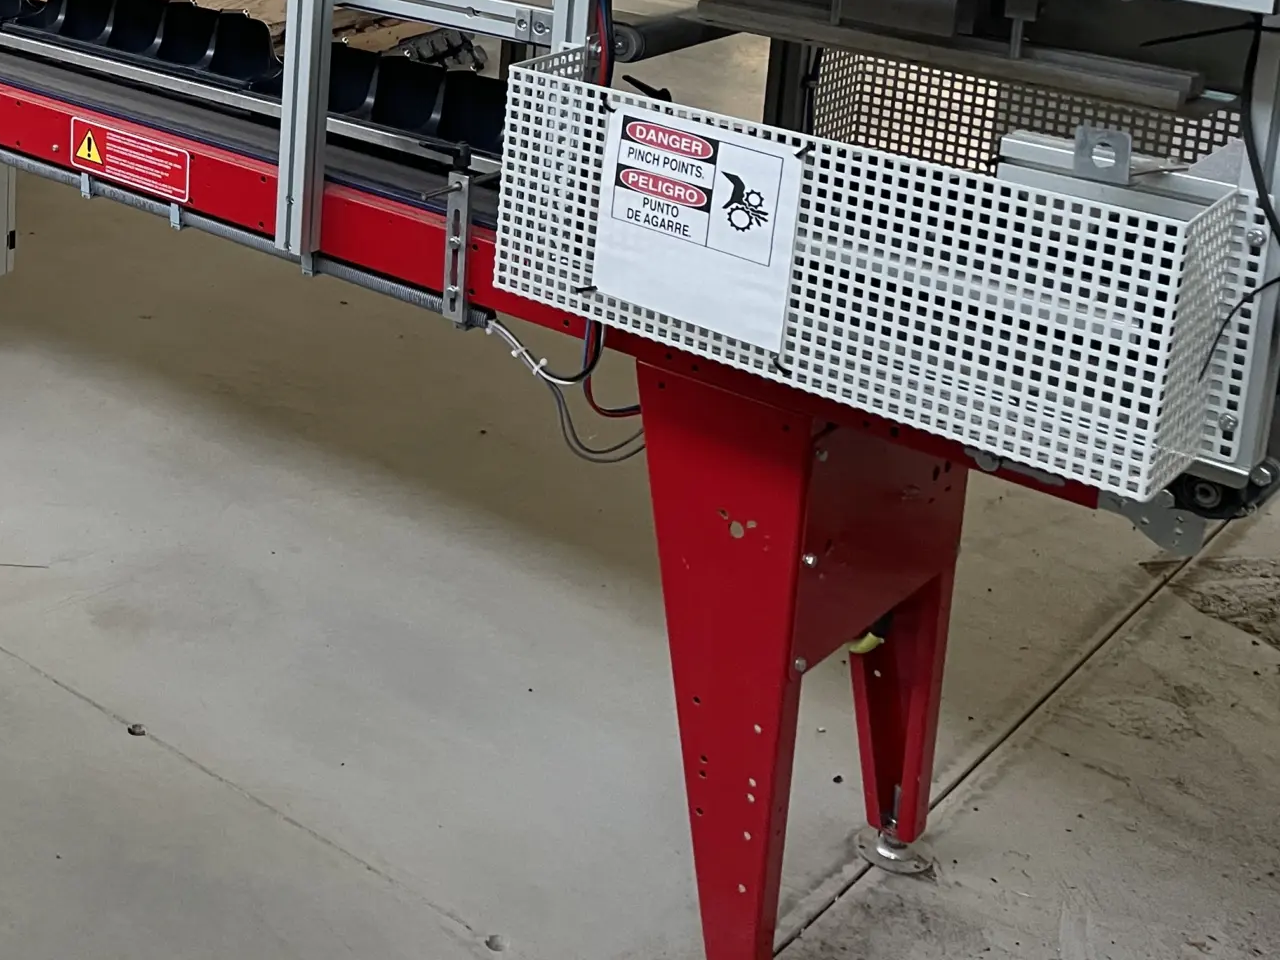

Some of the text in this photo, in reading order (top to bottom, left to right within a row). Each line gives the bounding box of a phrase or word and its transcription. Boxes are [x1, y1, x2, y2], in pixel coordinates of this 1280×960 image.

[635, 125, 703, 155] DANGER
[627, 146, 704, 179] PINCH POINTS.
[628, 172, 698, 203] PELIGRO
[626, 207, 691, 238] DE AGARRE.
[642, 197, 679, 218] PUNTO
